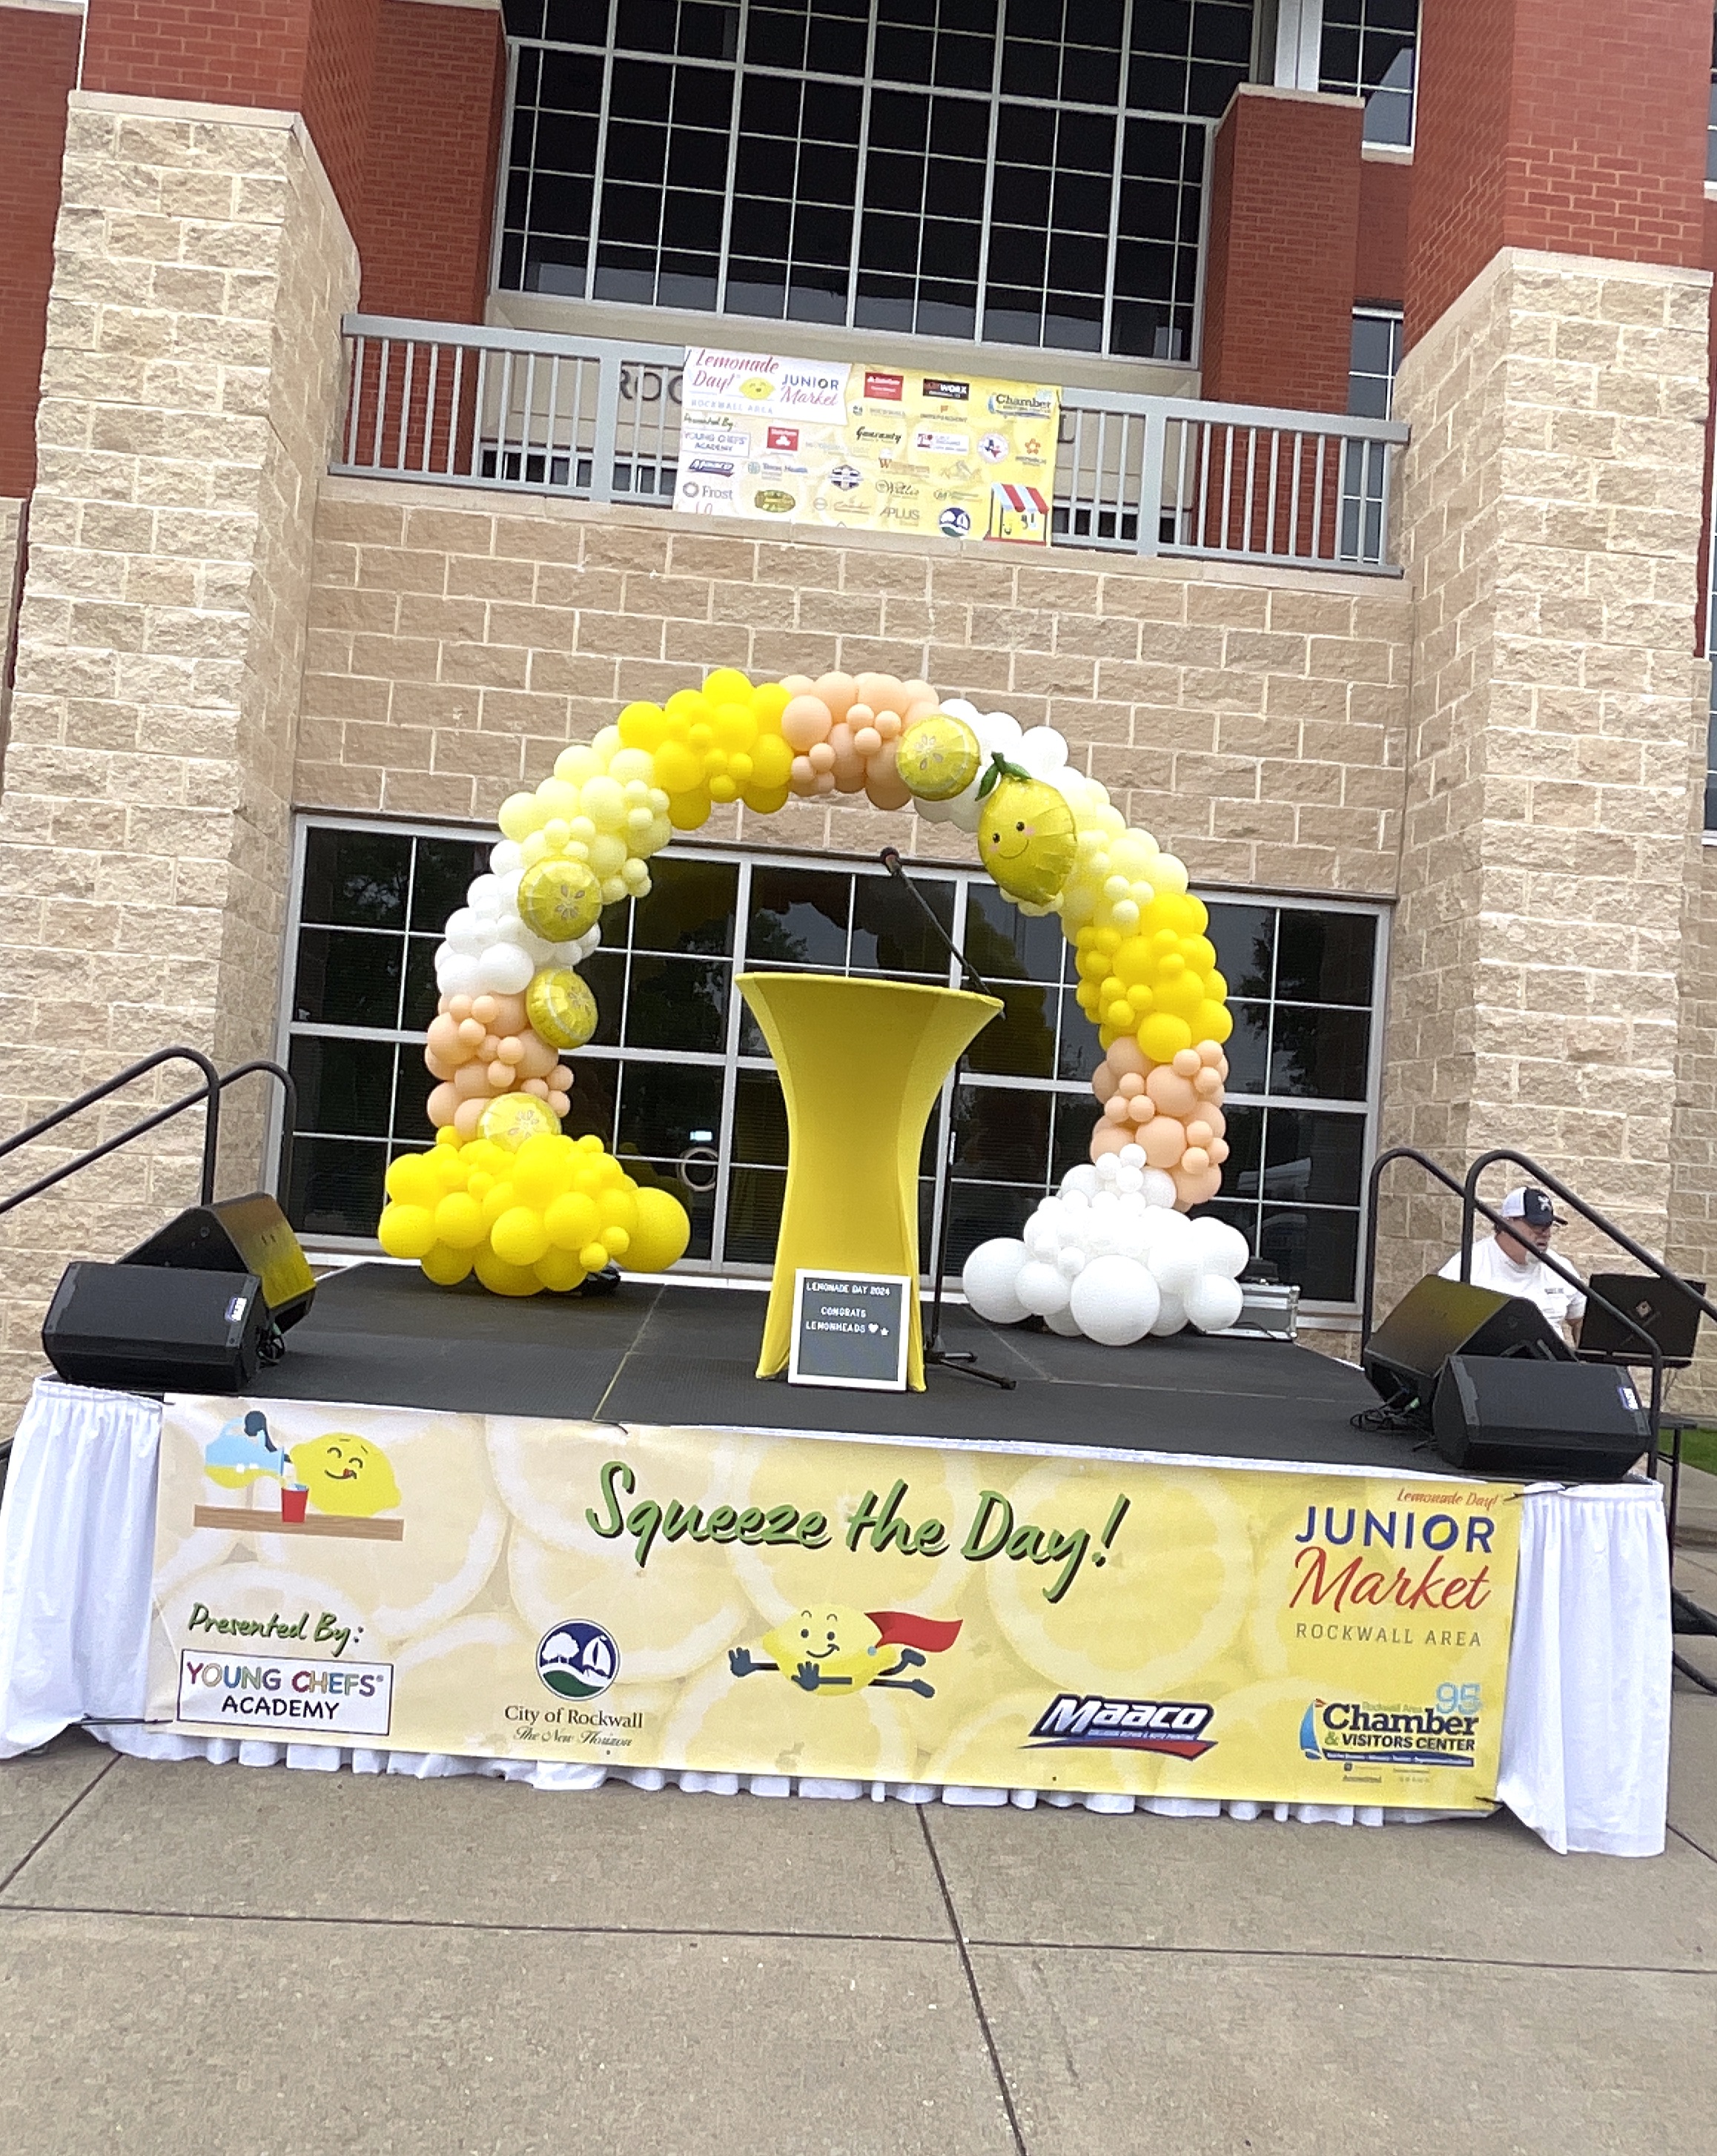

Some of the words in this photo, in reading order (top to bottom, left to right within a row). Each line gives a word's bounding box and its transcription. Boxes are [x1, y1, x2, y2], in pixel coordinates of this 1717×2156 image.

[695, 349, 779, 374] Lemonade
[692, 370, 735, 394] Day!
[781, 374, 838, 390] JUNIOR
[691, 400, 743, 411] ROCKWALL
[748, 405, 773, 414] AREA
[780, 386, 838, 406] Market
[996, 394, 1051, 409] Chamber
[702, 485, 732, 500] Frost
[806, 1282, 849, 1293] LEMONADE
[852, 1285, 867, 1294] DAY
[870, 1286, 890, 1296] 2024
[821, 1306, 867, 1317] CONGRATS
[806, 1320, 866, 1333] LEMONHEADS
[1397, 1487, 1463, 1506] Lemonade
[1466, 1492, 1498, 1512] Day!
[586, 1461, 831, 1567] Squeeze
[845, 1478, 950, 1555] the
[960, 1487, 1131, 1603] Day!
[1295, 1506, 1495, 1553] JUNIOR
[1289, 1546, 1492, 1613] Market
[188, 1602, 310, 1641] Presented
[314, 1612, 364, 1657] By:
[1297, 1623, 1413, 1644] ROCKWALL
[1425, 1630, 1481, 1647] AREA
[187, 1661, 281, 1691] YOUNG
[222, 1695, 340, 1720] ACADEMY
[1436, 1682, 1482, 1715] 95
[505, 1705, 540, 1725] City
[544, 1707, 564, 1723] of
[568, 1710, 644, 1728] Rockwall
[1036, 1696, 1211, 1734] Maaco
[1323, 1703, 1479, 1736] Chamber
[513, 1726, 540, 1741] The
[541, 1727, 574, 1743] New
[580, 1730, 632, 1746] Horizon
[1325, 1732, 1339, 1746] &
[1342, 1733, 1413, 1749] VISITORS
[1416, 1738, 1475, 1751] CENTER
